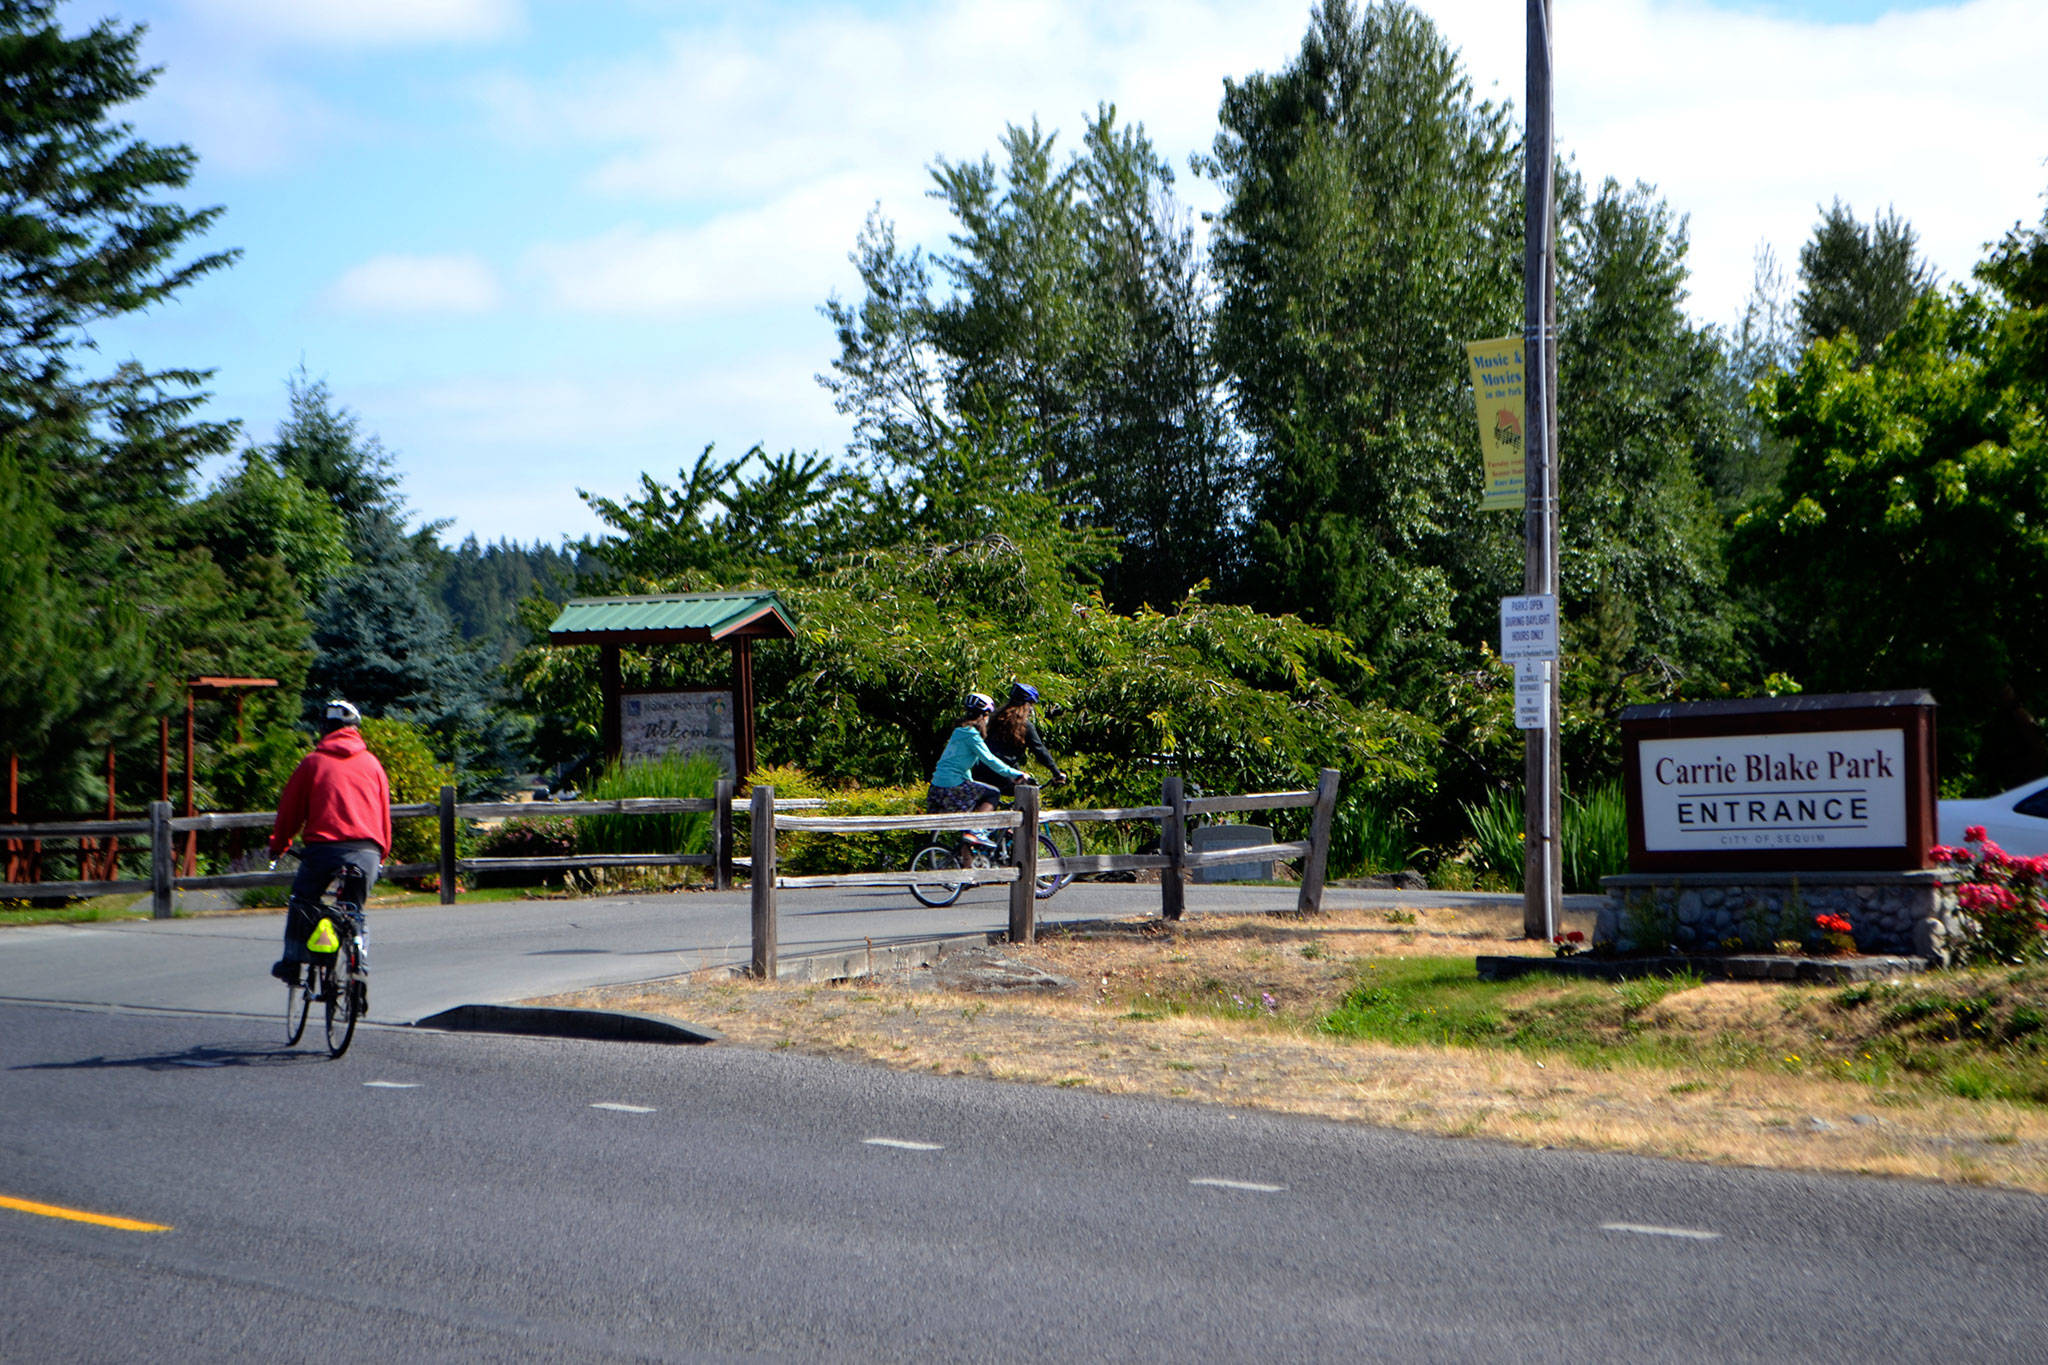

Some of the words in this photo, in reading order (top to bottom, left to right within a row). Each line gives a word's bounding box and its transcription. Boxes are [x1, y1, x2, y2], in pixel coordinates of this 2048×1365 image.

[1474, 352, 1509, 368] Music
[1514, 350, 1523, 363] &
[1482, 371, 1522, 386] Movies
[1512, 600, 1529, 611] PARKS
[1530, 599, 1544, 610] OPEN
[1505, 616, 1525, 627] DURING
[1526, 614, 1551, 626] DAYLIGHT
[1512, 631, 1529, 642] HOURS
[1531, 629, 1544, 640] ONLY
[644, 719, 713, 739] Welcome
[1655, 756, 1737, 786] Carrie
[1745, 753, 1820, 783] Blake
[1828, 749, 1894, 780] Park
[1677, 798, 1869, 824] ENTRANCE
[1720, 834, 1748, 845] CITY
[1755, 834, 1771, 844] OF
[1776, 833, 1826, 843] SEQUIM
